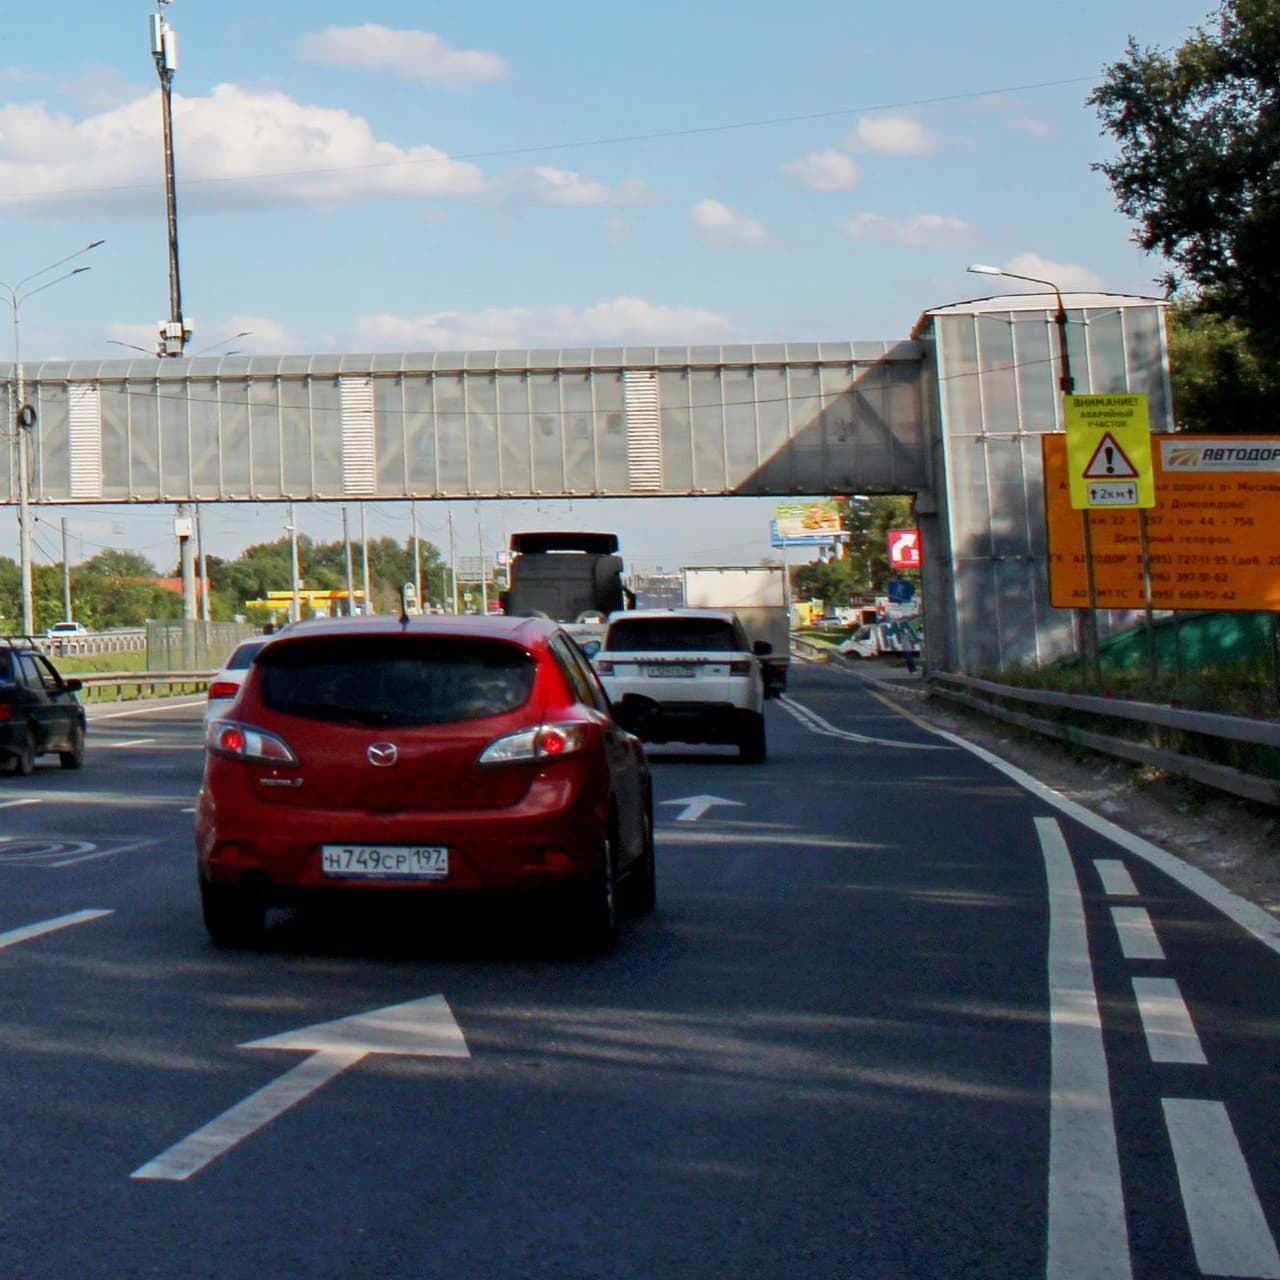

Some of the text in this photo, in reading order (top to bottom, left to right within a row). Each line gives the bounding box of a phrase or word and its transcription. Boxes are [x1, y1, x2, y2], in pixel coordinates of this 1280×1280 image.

[1073, 397, 1138, 408] ВНИМАНИЕ!
[1087, 420, 1128, 428] УЧАСТОК
[1202, 447, 1280, 461] АВТОДОР
[1113, 532, 1174, 544] Дежрный
[328, 848, 442, 869] Н749СР 197
